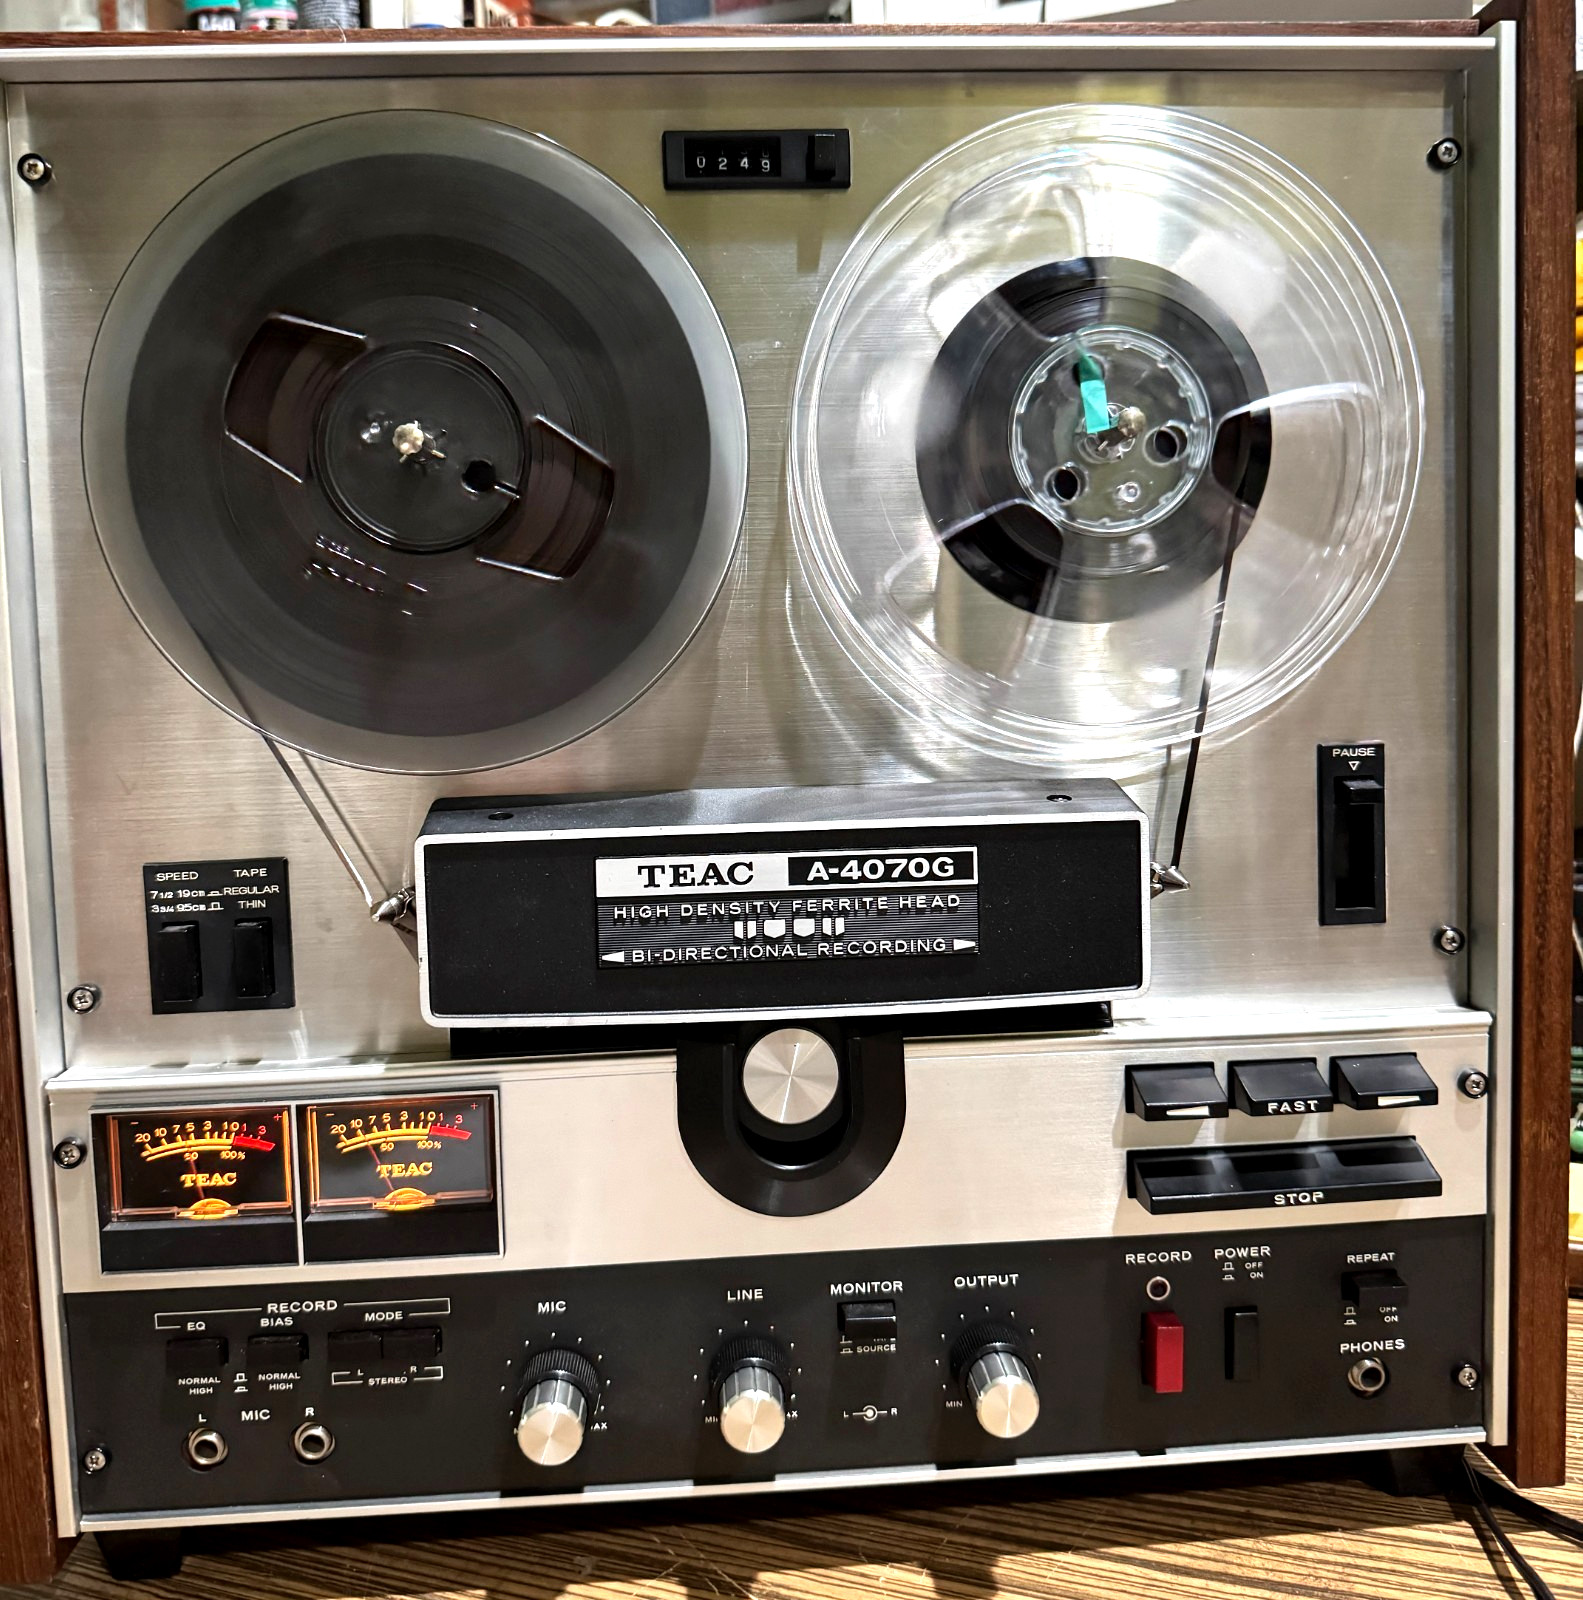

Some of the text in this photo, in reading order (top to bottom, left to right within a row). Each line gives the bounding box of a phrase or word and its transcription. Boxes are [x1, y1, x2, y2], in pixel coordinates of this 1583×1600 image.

[1332, 747, 1376, 757] PAUSE
[156, 871, 199, 881] SPEED
[233, 868, 268, 877] TAPE
[637, 856, 955, 888] TEAC A-4070G
[223, 885, 280, 896] REGULAR
[237, 900, 266, 908] THIN
[613, 895, 961, 919] HIGH DENSITY FERRITE HEAD
[632, 938, 946, 963] BI-DIRECTIONAL RECORDING
[1267, 1100, 1319, 1114] FAST
[330, 1124, 346, 1135] 20
[350, 1118, 363, 1129] 10
[368, 1115, 377, 1125] 7
[382, 1113, 391, 1122] 5
[399, 1111, 409, 1121] 3
[455, 1114, 463, 1124] 3
[135, 1132, 151, 1143] 20
[154, 1127, 167, 1137] 10
[172, 1124, 181, 1134] 7
[186, 1122, 195, 1132] 5
[203, 1120, 212, 1130] 3
[257, 1125, 267, 1135] 3
[380, 1142, 394, 1152] 50
[376, 1161, 433, 1178] TEAC
[180, 1171, 237, 1188] TEAC
[1274, 1192, 1324, 1206] STOP
[1125, 1250, 1193, 1265] RECORD
[1214, 1245, 1271, 1260] POWER
[1346, 1252, 1396, 1265] REPEAT
[1244, 1261, 1264, 1270] OFF
[954, 1273, 1019, 1289] OUTPUT
[1249, 1271, 1264, 1279] ON
[727, 1288, 764, 1301] LINE
[830, 1280, 904, 1297] MONITOR
[266, 1299, 338, 1314] RECORD
[537, 1300, 567, 1314] MIC
[260, 1316, 294, 1328] BIAS
[364, 1310, 404, 1322] MODE
[1384, 1315, 1399, 1323] ON
[186, 1321, 207, 1331] EQ
[856, 1344, 897, 1353] SOURCE
[1339, 1338, 1406, 1354] PHONES
[410, 1365, 418, 1373] R
[178, 1376, 221, 1386] NORMAL
[257, 1372, 301, 1382] NORMAL
[368, 1376, 408, 1386] STEREO
[188, 1386, 214, 1395] HIGH
[268, 1382, 294, 1391] HIGH
[945, 1400, 964, 1409] MIN
[198, 1407, 315, 1423] L MIC R
[891, 1407, 898, 1415] R
